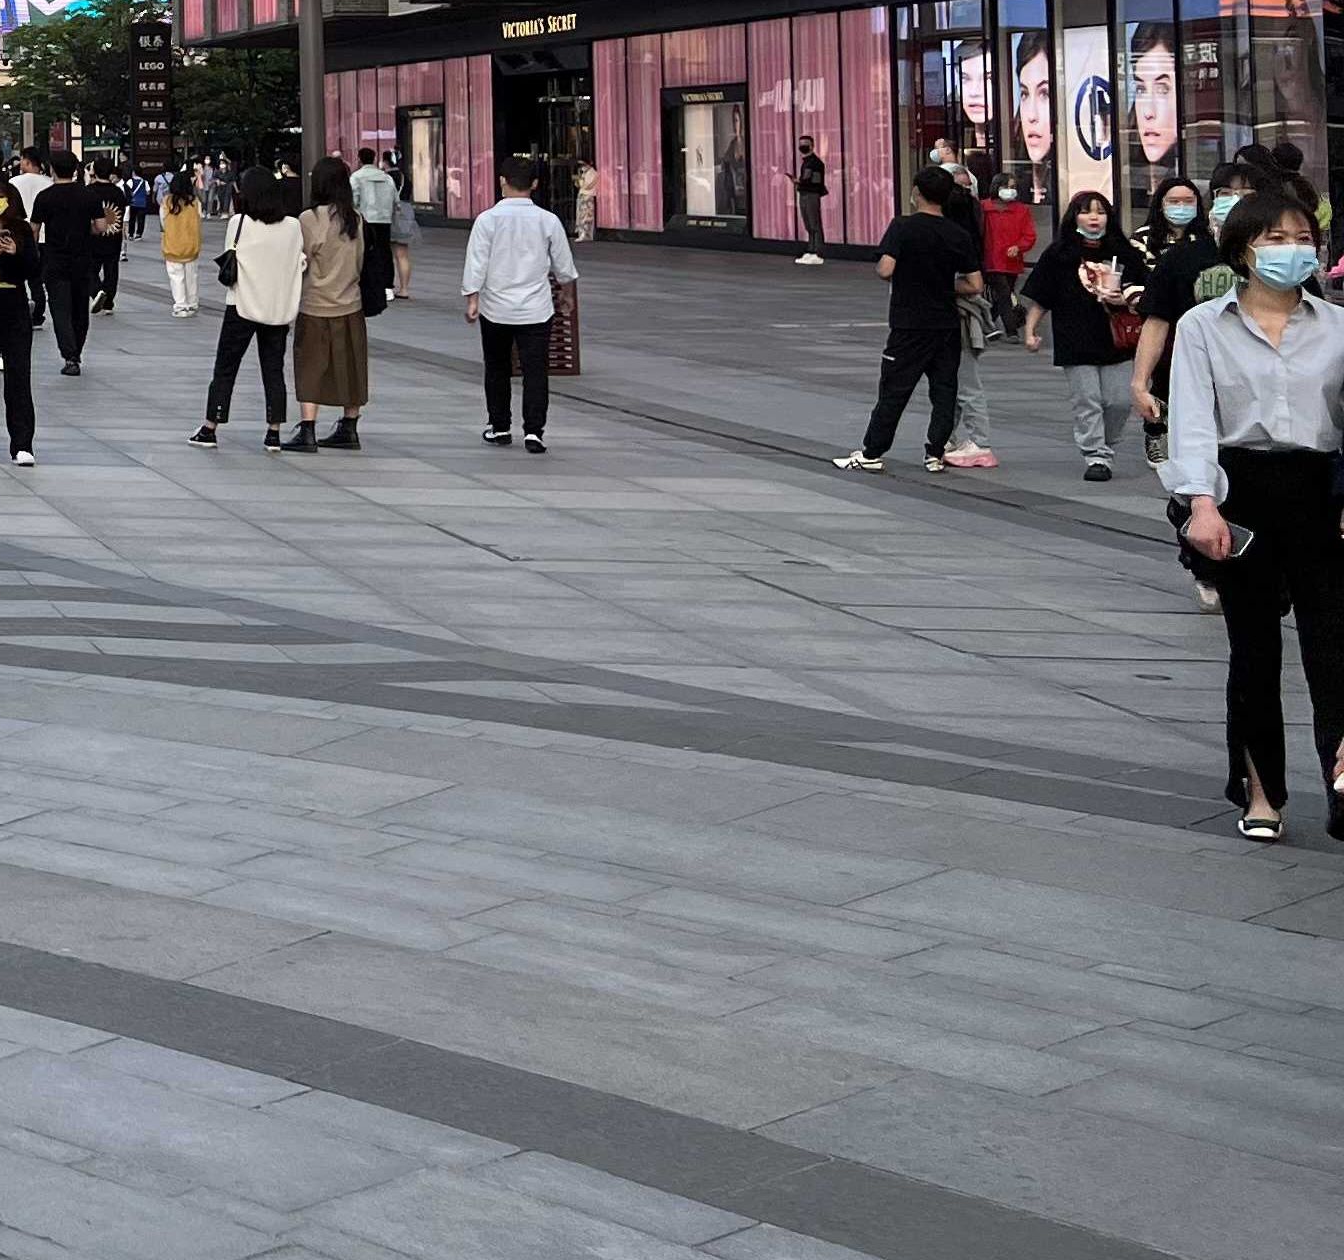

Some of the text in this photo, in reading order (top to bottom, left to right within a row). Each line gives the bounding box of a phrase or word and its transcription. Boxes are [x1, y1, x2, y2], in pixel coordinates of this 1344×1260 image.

[502, 13, 577, 39] VICTORIA'S SECRET
[139, 62, 165, 70] LEGO
